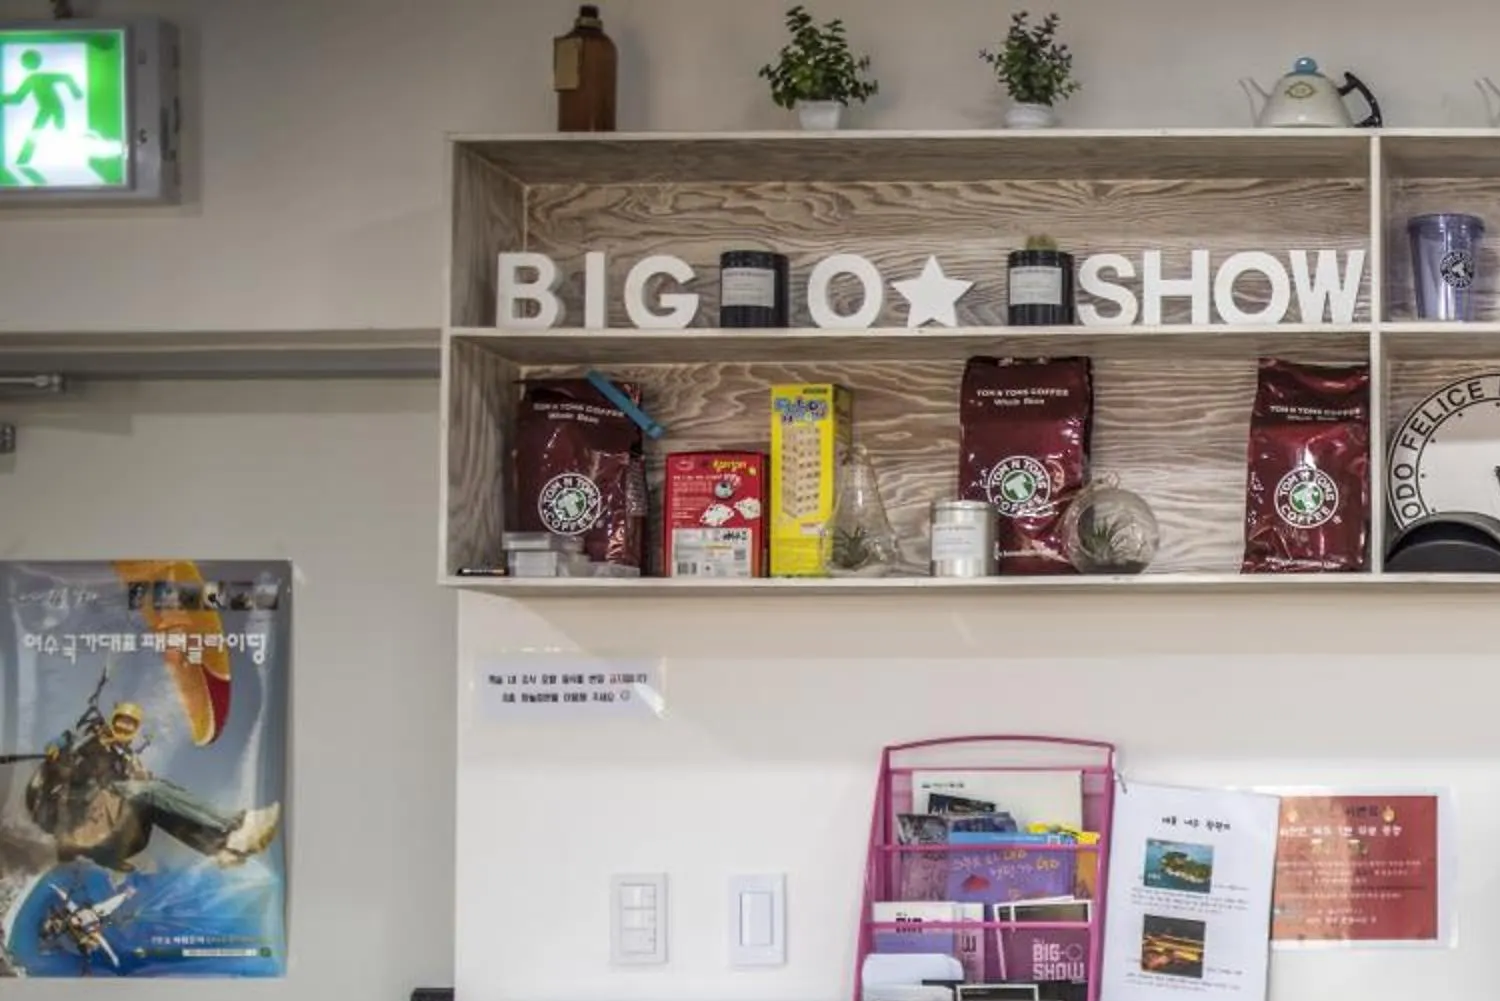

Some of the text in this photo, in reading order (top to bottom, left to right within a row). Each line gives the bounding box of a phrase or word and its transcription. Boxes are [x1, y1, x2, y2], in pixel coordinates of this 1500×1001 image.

[497, 251, 699, 329] BIG
[807, 253, 884, 328] O
[1077, 250, 1366, 326] SHOW
[1400, 380, 1485, 451] FELICE
[1281, 505, 1332, 525] COFFEE
[1033, 962, 1086, 981] SHOW
